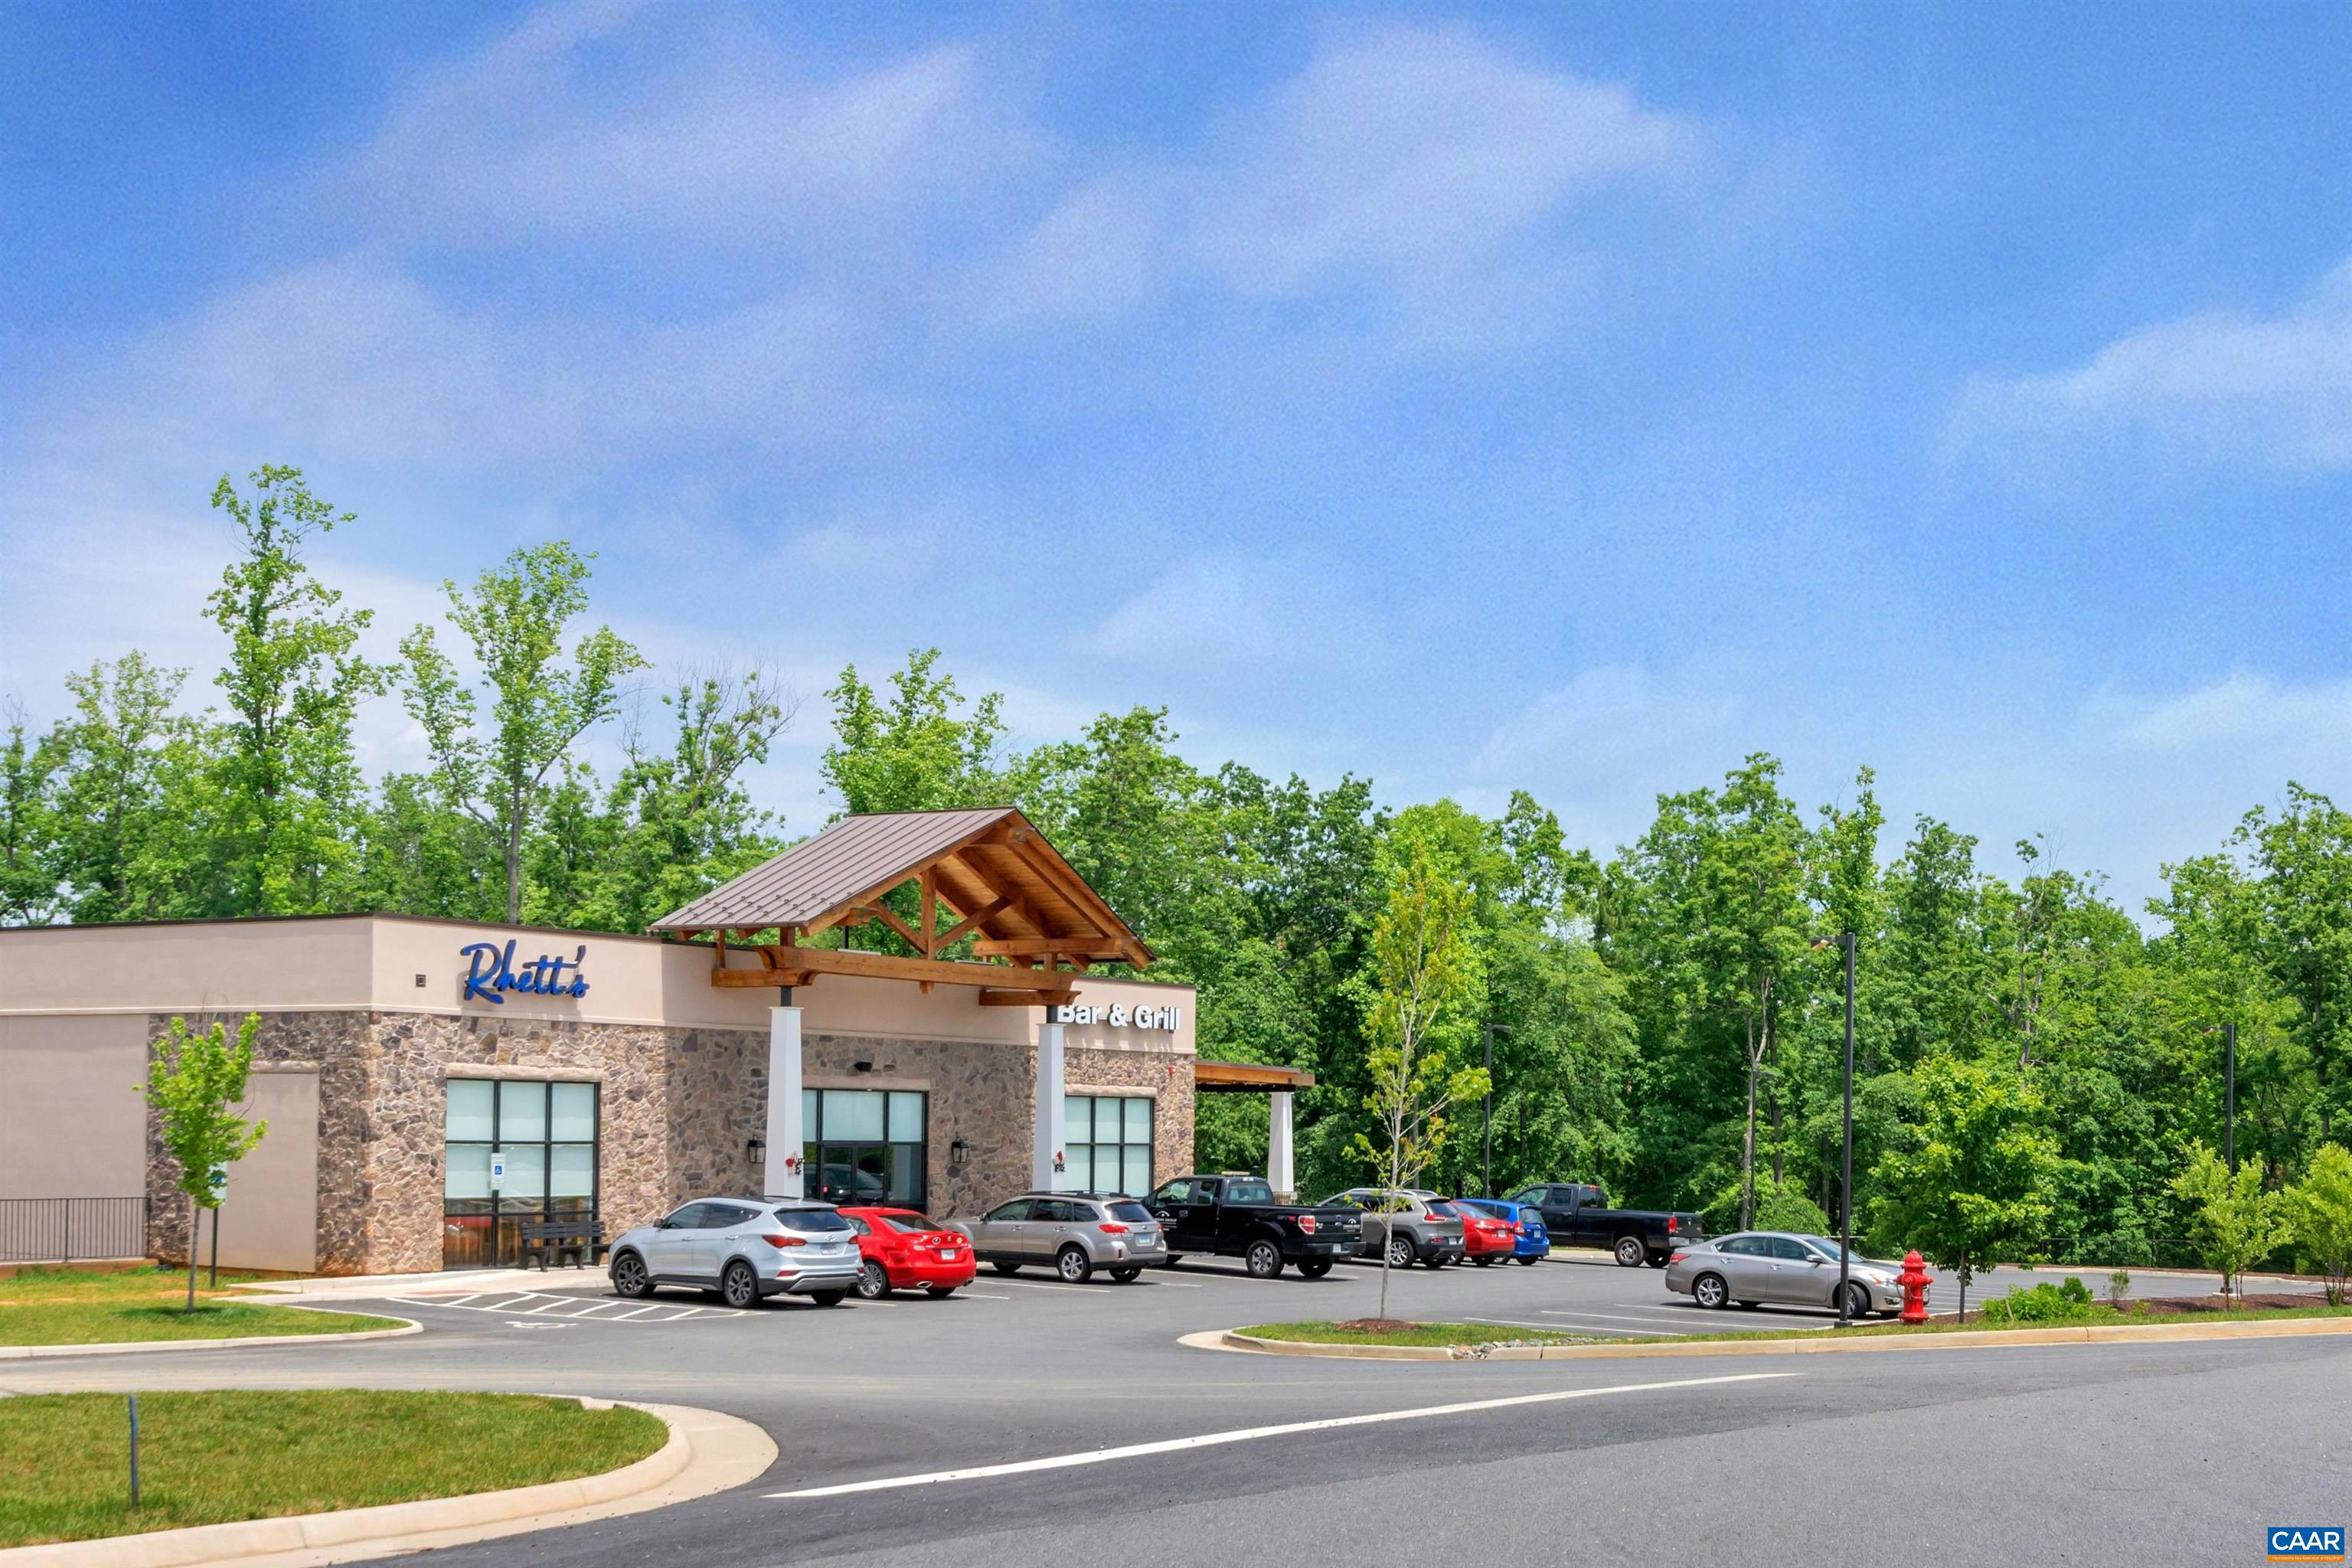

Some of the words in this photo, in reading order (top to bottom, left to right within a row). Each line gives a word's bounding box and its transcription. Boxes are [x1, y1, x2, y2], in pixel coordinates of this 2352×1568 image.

[460, 939, 590, 1004] Rhett's
[1057, 1004, 1102, 1024] Bar
[1108, 1004, 1128, 1027] &
[1133, 1004, 1181, 1031] Grill
